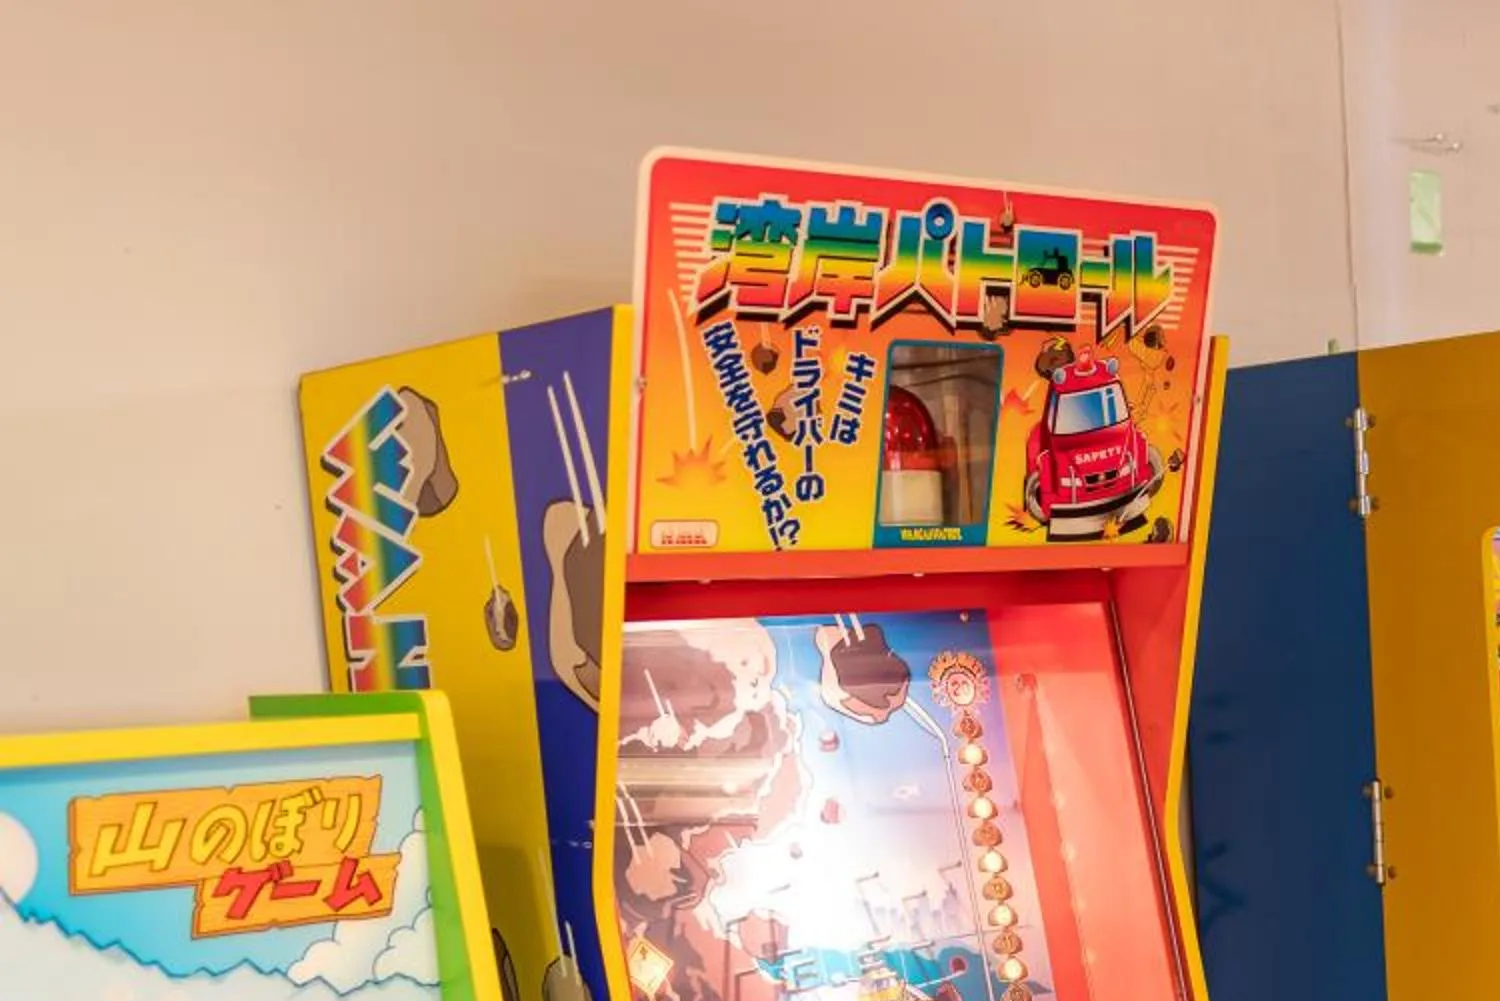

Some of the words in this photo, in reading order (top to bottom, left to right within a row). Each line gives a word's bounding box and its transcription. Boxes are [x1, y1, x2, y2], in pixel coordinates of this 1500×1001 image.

[689, 194, 1174, 336] 湾岸パトロール
[791, 327, 826, 501] ドライバーの
[830, 353, 876, 445] キミは
[90, 787, 363, 876] 山のぼり
[213, 857, 382, 919] ゲーム
